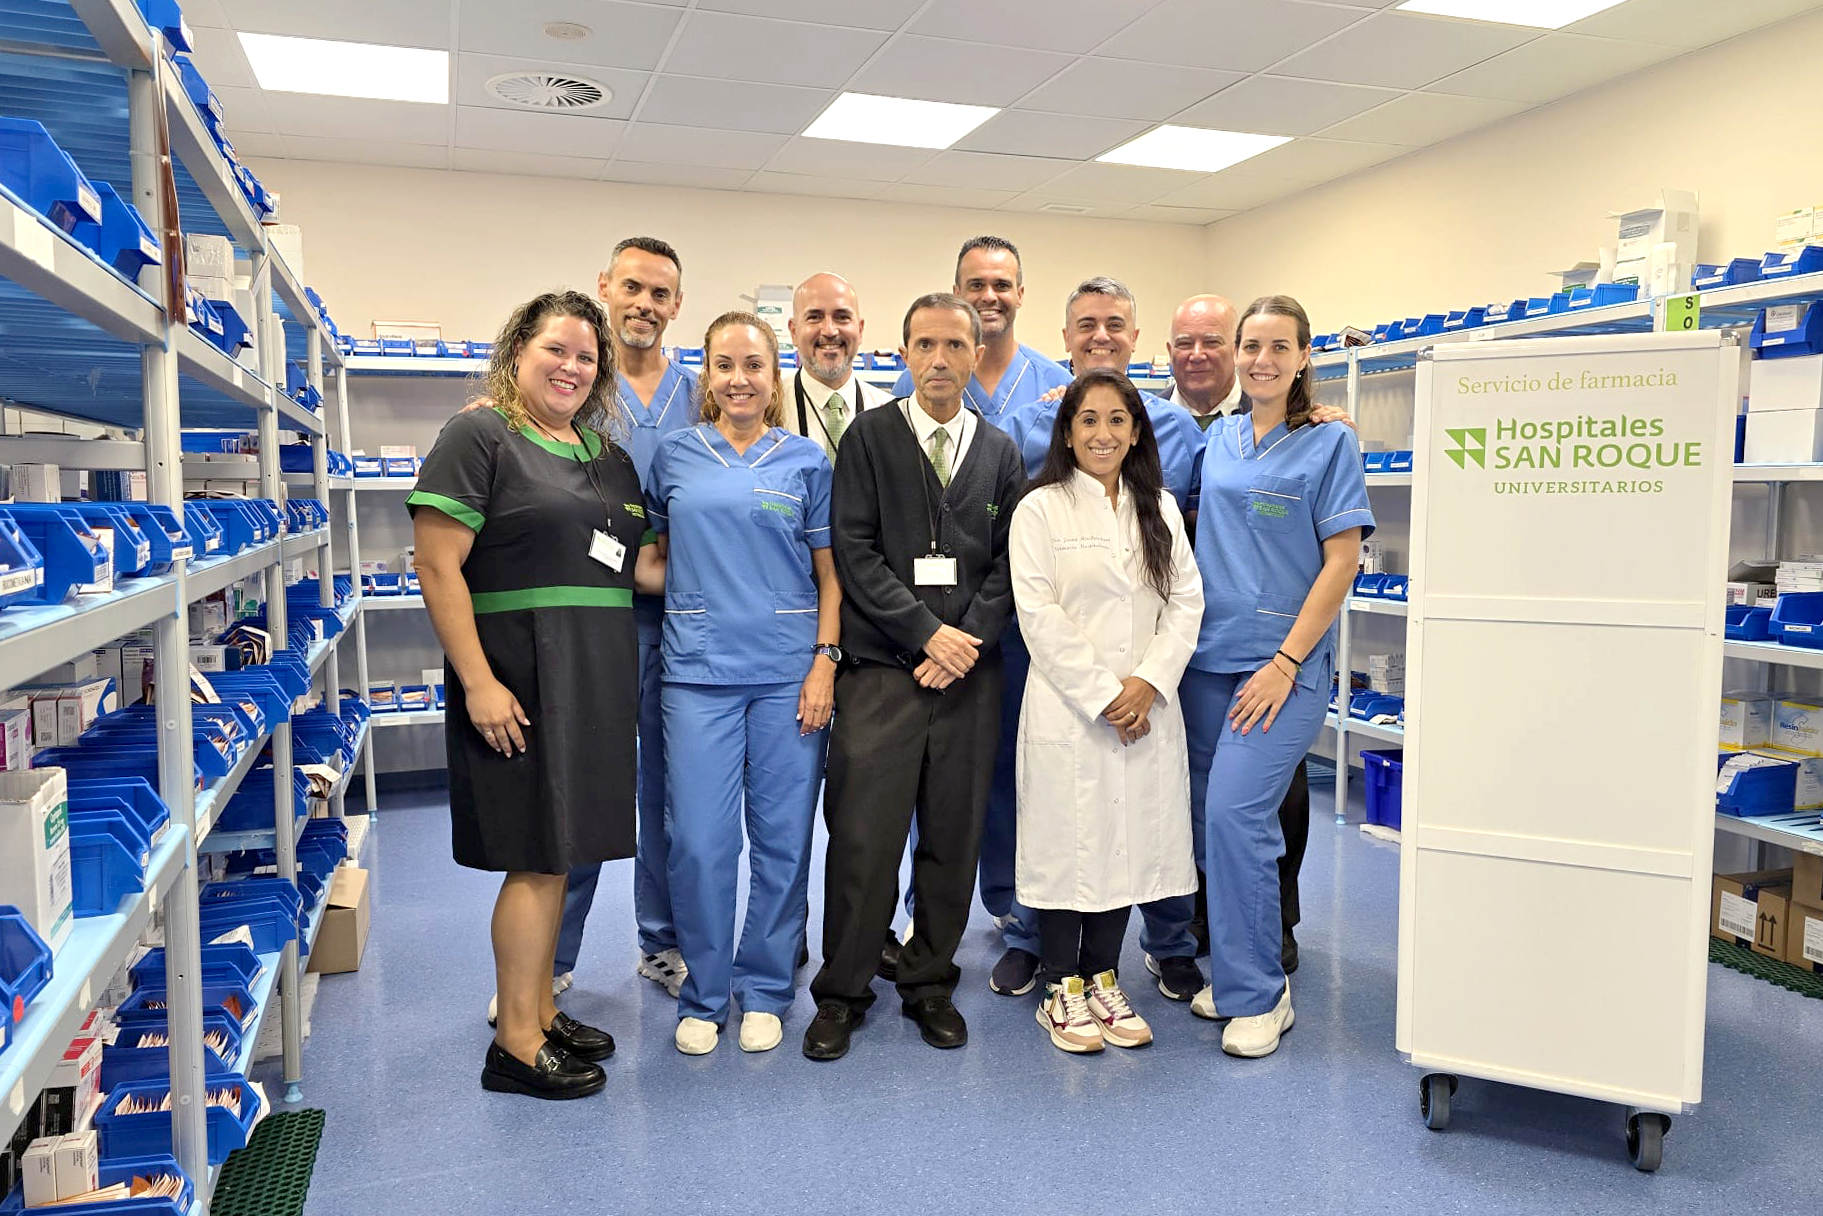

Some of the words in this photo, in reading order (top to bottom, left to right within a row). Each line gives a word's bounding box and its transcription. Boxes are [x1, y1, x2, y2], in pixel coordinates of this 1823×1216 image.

[1686, 296, 1694, 310] S
[1457, 375, 1542, 395] Servicio
[1548, 372, 1573, 391] de
[1580, 368, 1678, 390] farmacia
[1496, 414, 1665, 445] Hospitales
[1494, 444, 1561, 470] SAN
[1573, 442, 1702, 470] ROQUE
[1494, 480, 1664, 494] UNIVERSITARIOS
